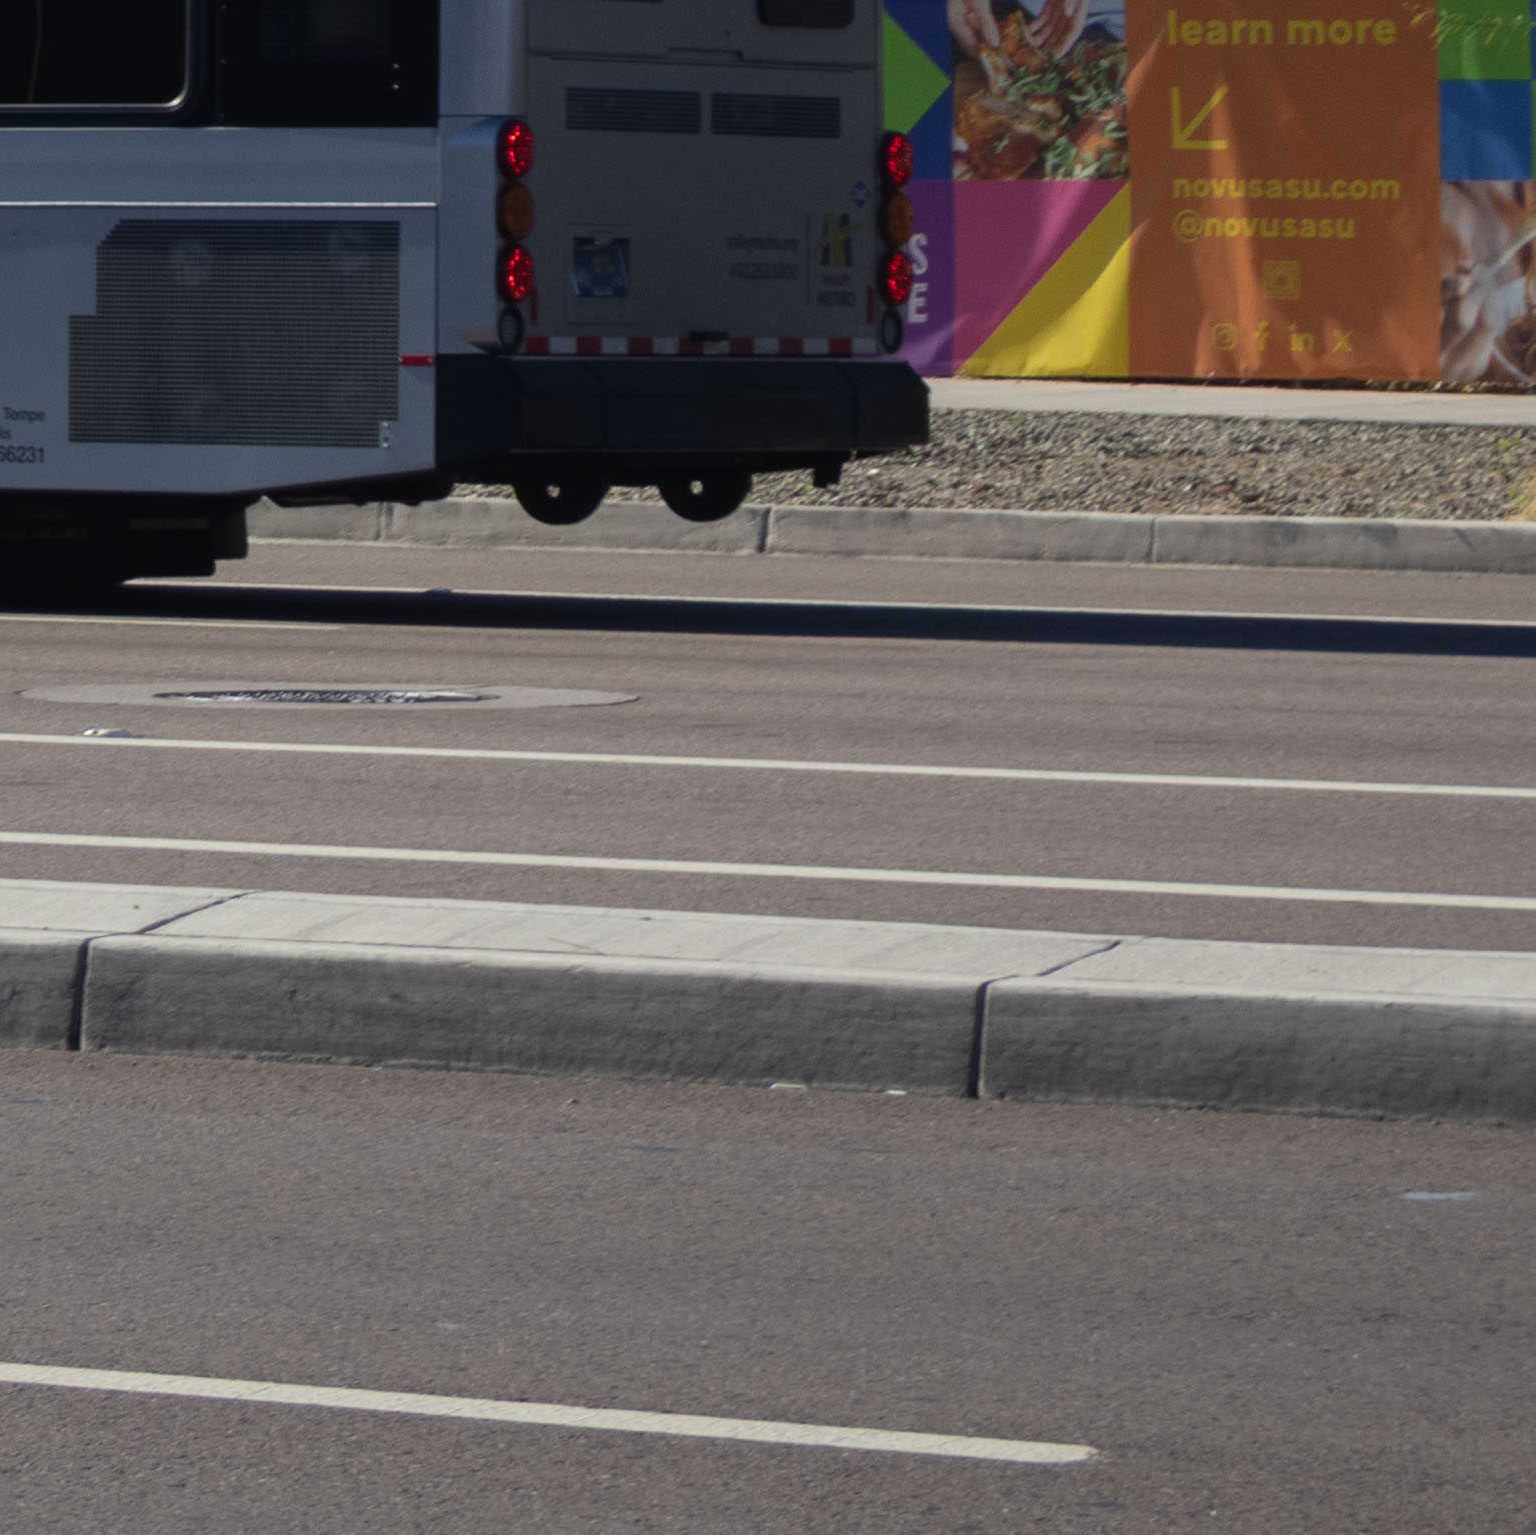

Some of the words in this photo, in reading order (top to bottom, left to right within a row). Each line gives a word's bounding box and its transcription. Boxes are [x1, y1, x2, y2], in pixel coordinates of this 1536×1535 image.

[1167, 10, 1274, 46] learn
[1287, 18, 1398, 46] more
[1173, 178, 1401, 201] novusasu.com
[1173, 208, 1355, 243] @novusasu
[3, 406, 47, 422] Tempe
